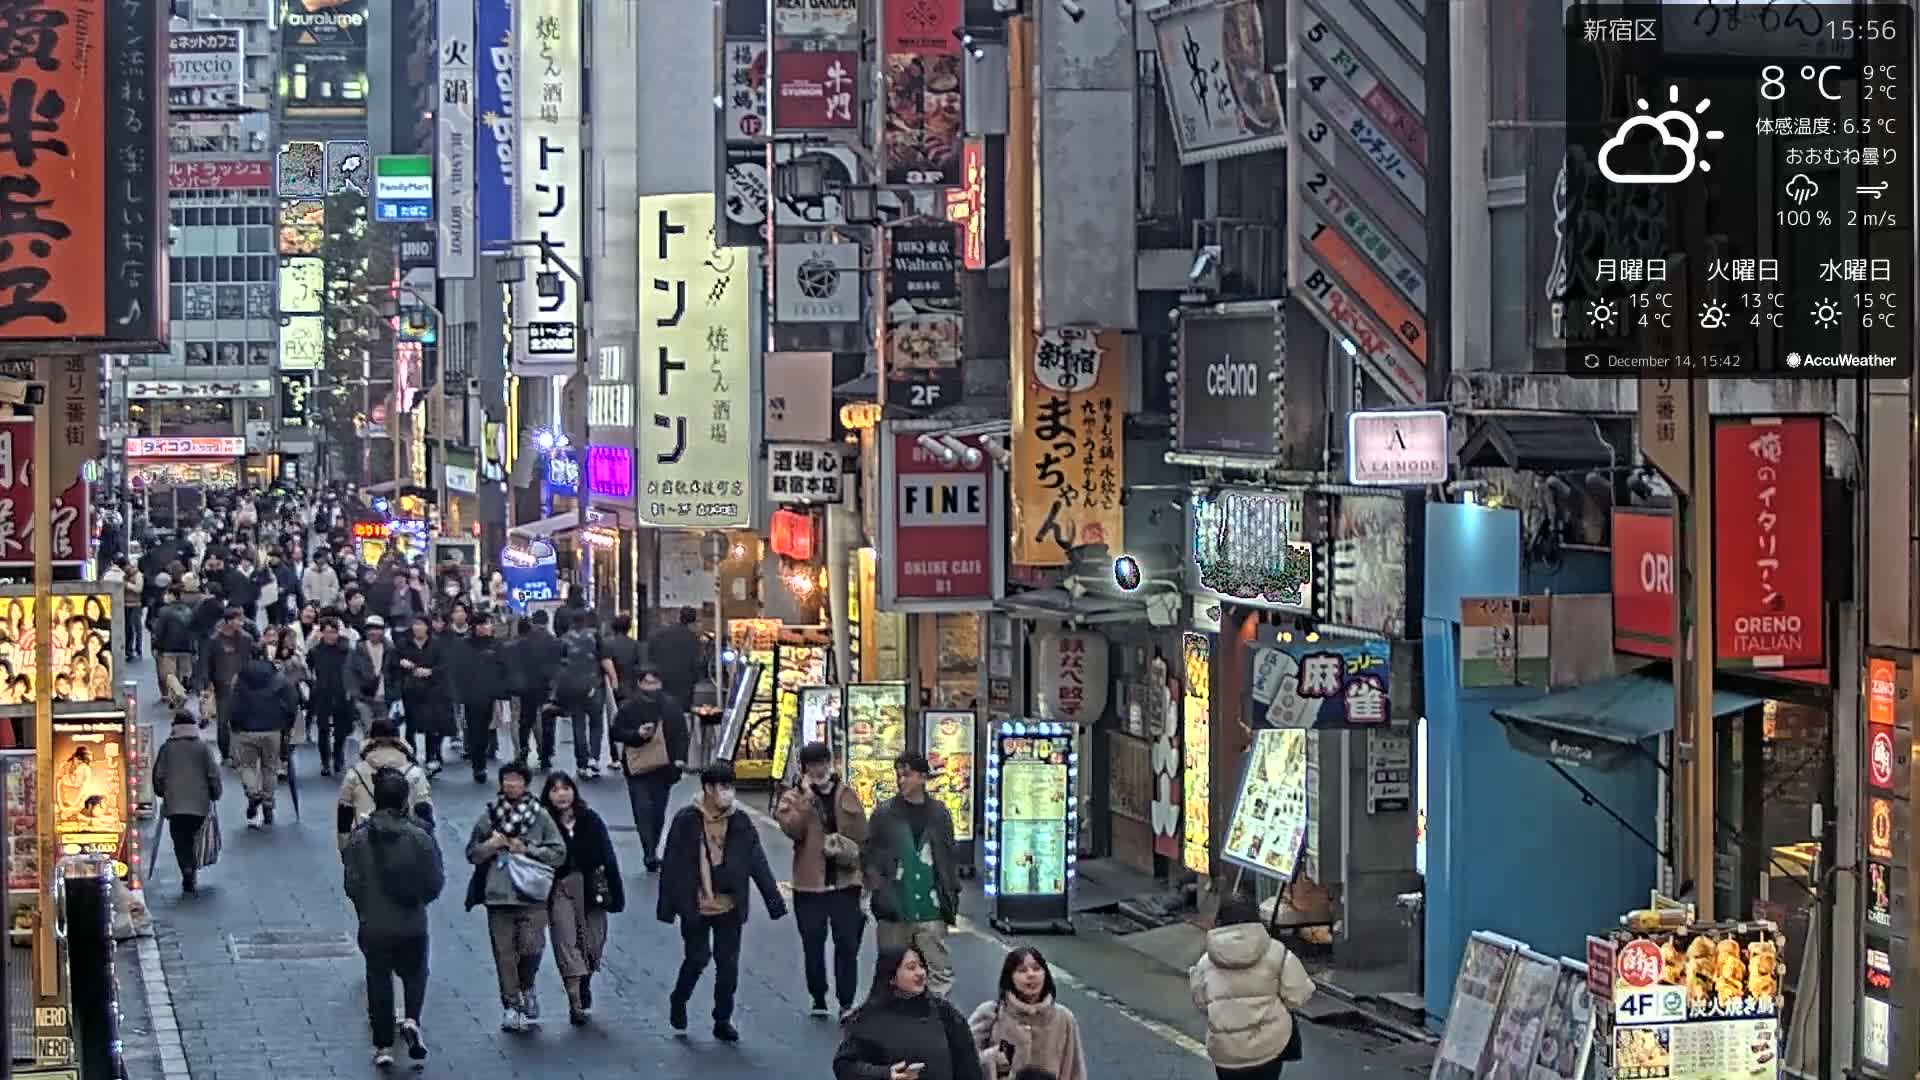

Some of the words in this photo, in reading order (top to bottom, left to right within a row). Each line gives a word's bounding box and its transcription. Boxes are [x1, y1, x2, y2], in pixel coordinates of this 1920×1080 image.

[1308, 22, 1328, 43] 5
[443, 40, 468, 104] 火鍋
[1308, 75, 1327, 91] 4
[1308, 122, 1327, 142] 3
[1350, 119, 1405, 179] センチュリー
[380, 182, 430, 192] FamilyMart
[1306, 173, 1327, 194] 2
[1312, 222, 1326, 241] 1
[894, 256, 953, 272] Walton's
[1305, 269, 1333, 299] B1
[654, 210, 687, 464] トントン
[1038, 338, 1097, 376] 新宿
[1058, 374, 1078, 388] の
[1207, 353, 1258, 396] celona
[911, 385, 941, 406] 2F
[773, 450, 837, 473] 酒場心
[1035, 396, 1079, 548] まっちゃん
[773, 475, 837, 495] 新宿本店
[904, 485, 981, 514] FINE
[1750, 431, 1782, 603] 俺のイタリアン
[904, 560, 948, 577] ONLINE
[1735, 617, 1801, 633] ORENO
[1734, 635, 1801, 651] ITALIAN
[1300, 654, 1387, 721] 麻雀
[1619, 994, 1654, 1016] 4F
[35, 1007, 66, 1026] NERO
[38, 1037, 68, 1057] NERO
